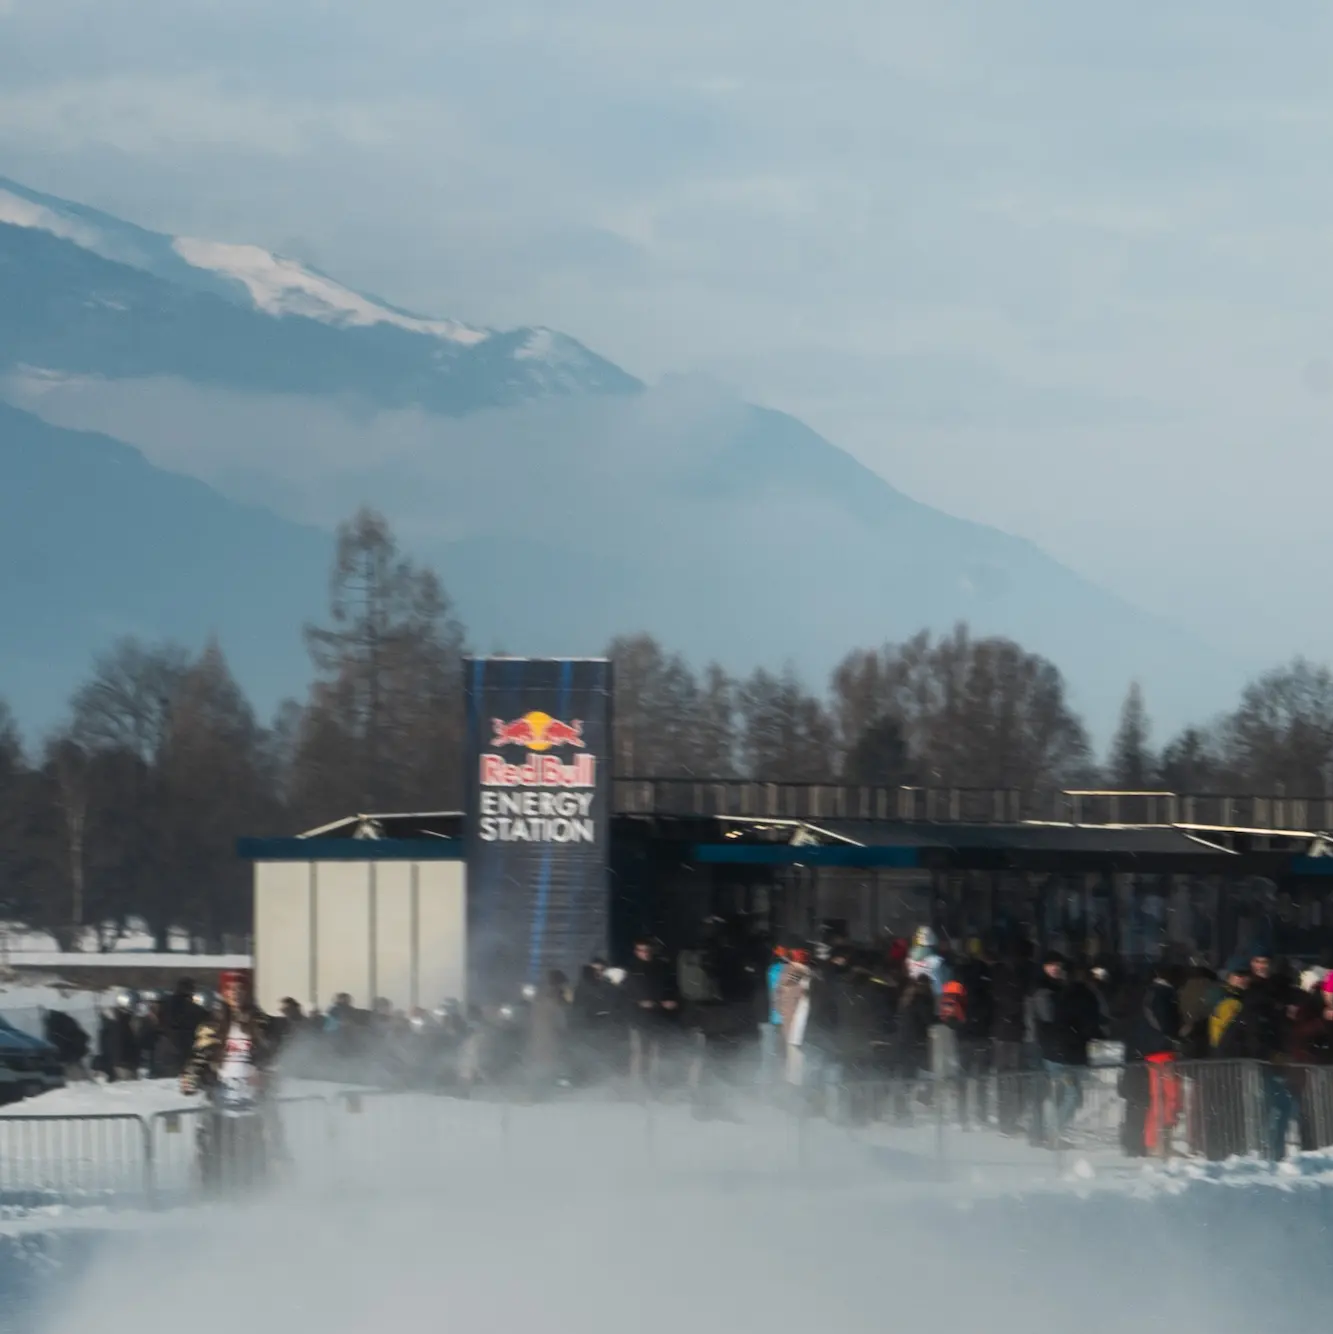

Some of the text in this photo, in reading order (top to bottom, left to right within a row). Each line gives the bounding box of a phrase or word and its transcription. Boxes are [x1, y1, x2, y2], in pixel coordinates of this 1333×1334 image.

[480, 754, 595, 786] Red Bull
[480, 791, 594, 816] ENERGY
[479, 817, 594, 842] STATION
